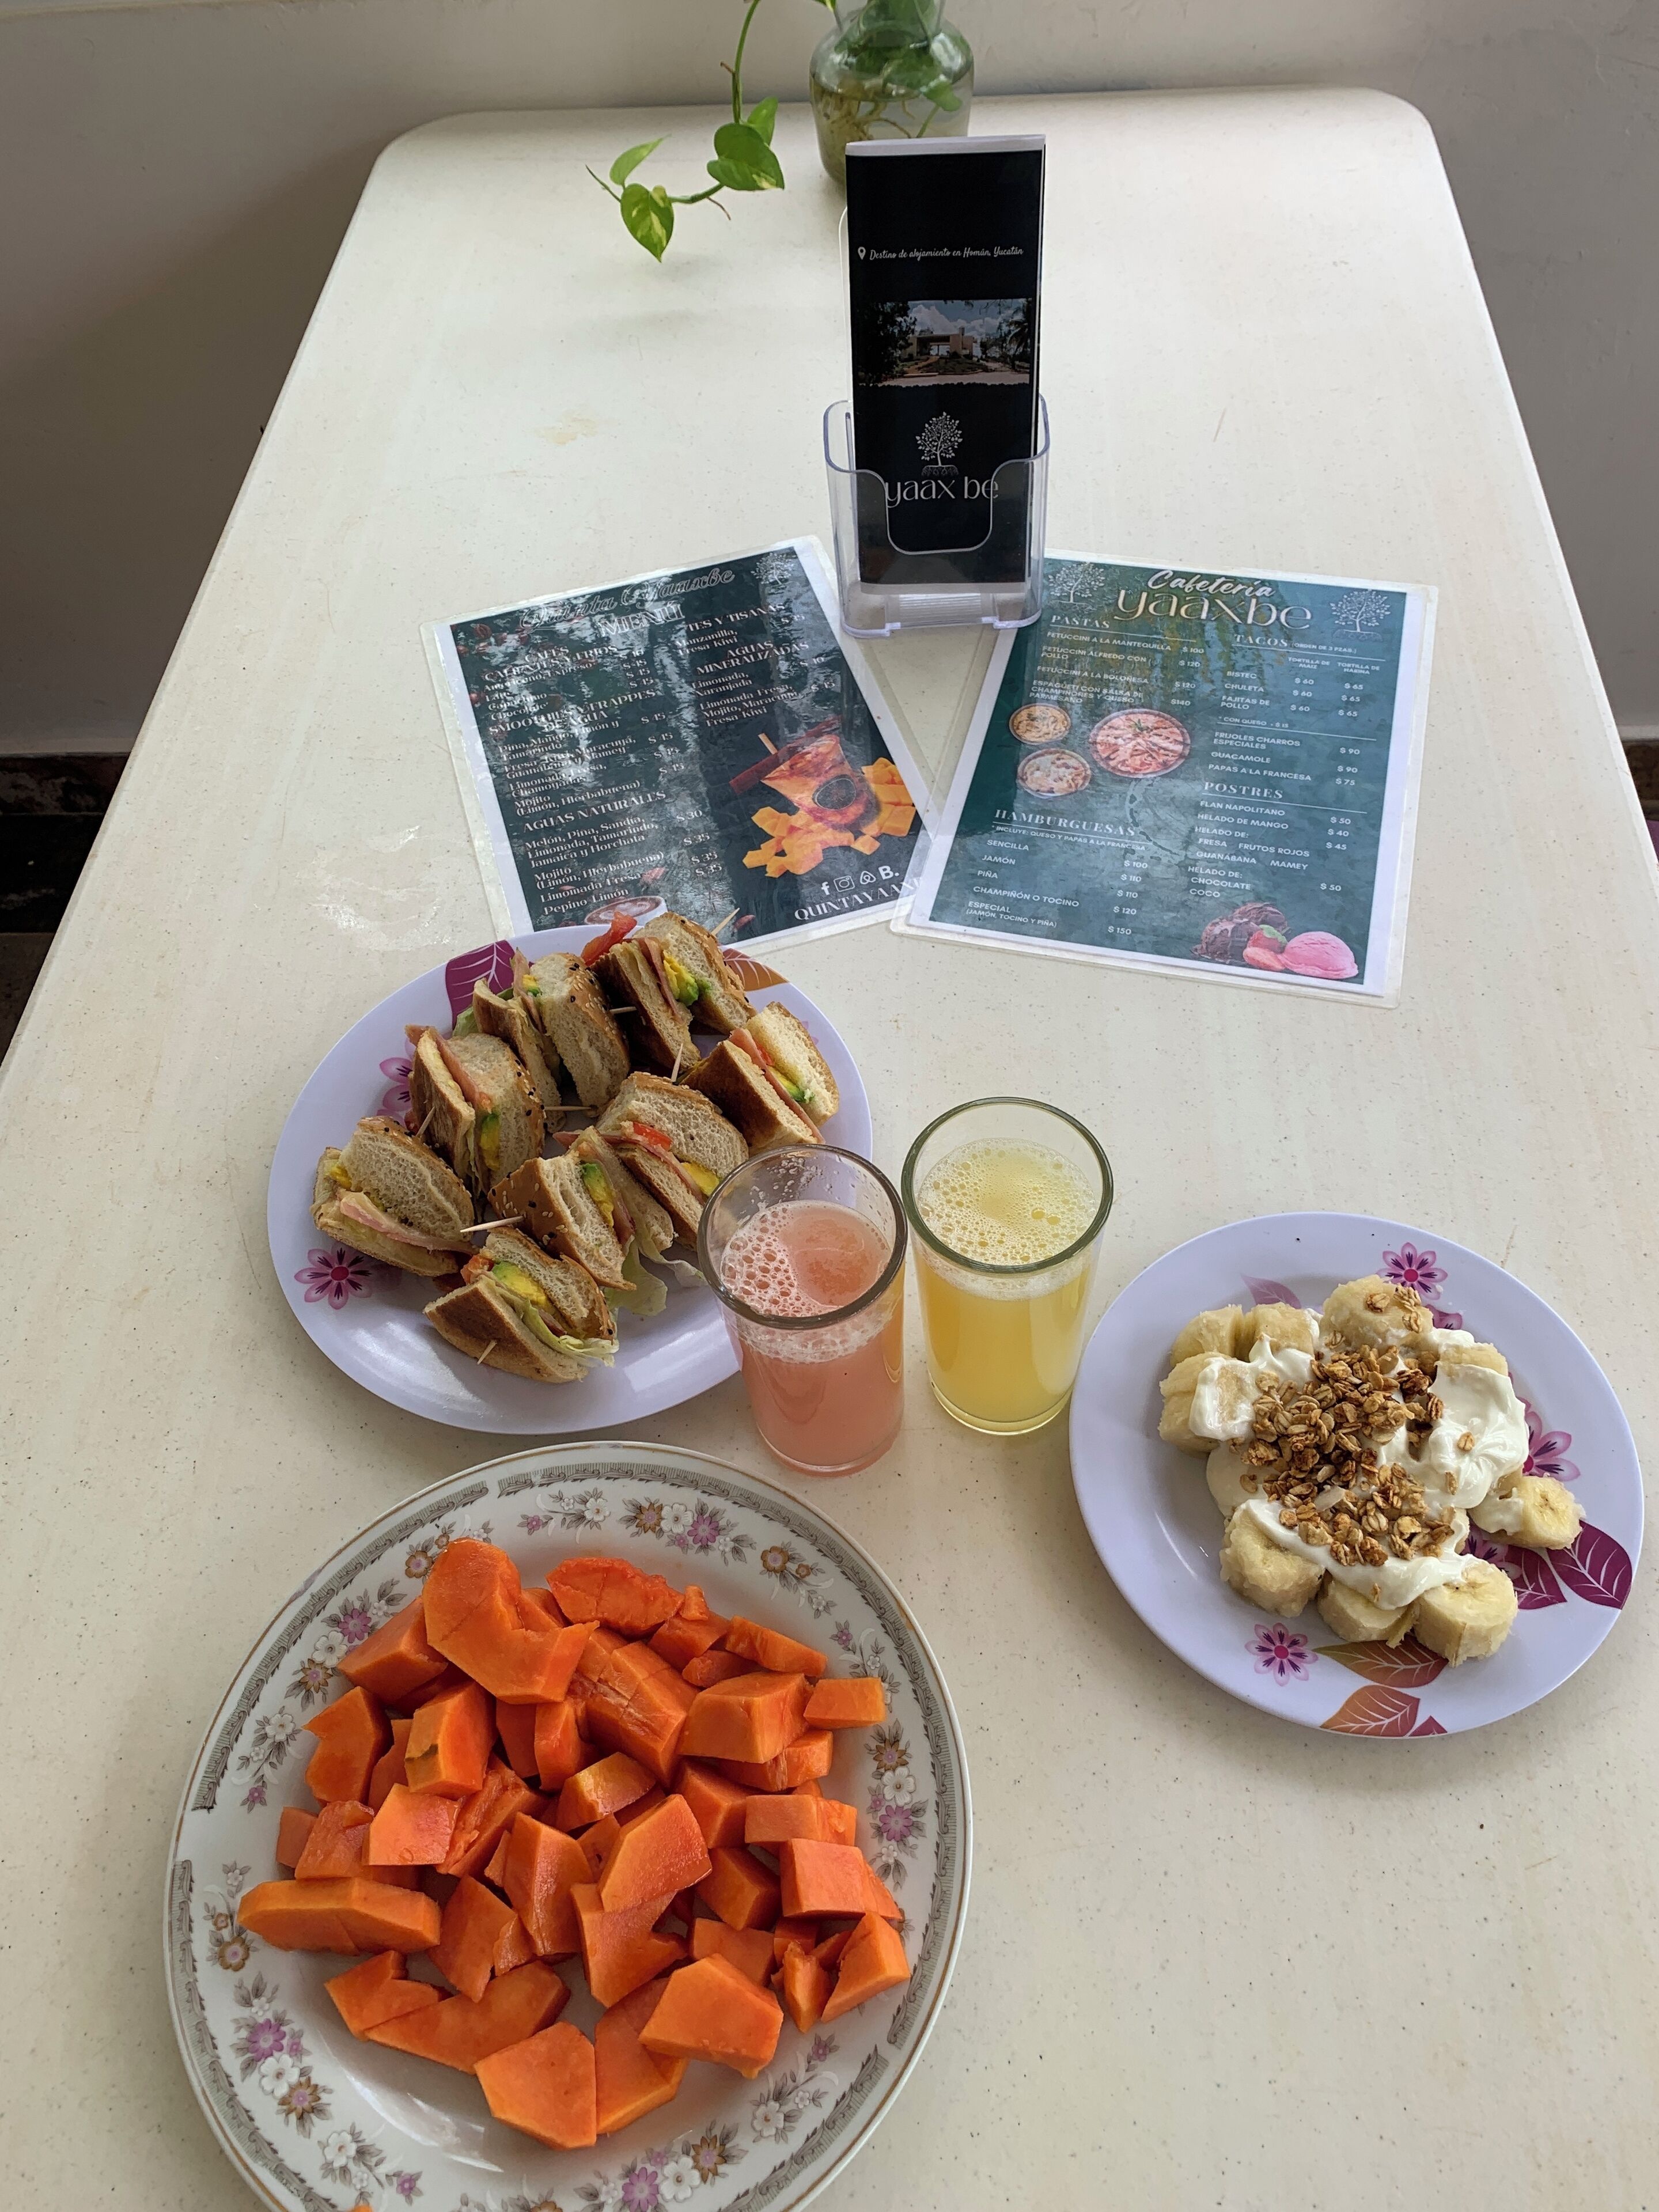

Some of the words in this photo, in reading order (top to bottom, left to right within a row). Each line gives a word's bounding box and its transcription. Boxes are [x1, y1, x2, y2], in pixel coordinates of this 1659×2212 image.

[870, 249, 896, 260] Destino
[899, 249, 908, 257] de
[909, 248, 950, 261] alojamiento
[993, 246, 1024, 257] Yucatán
[885, 479, 955, 508] yaax
[964, 476, 998, 499] be
[1147, 569, 1275, 597] Cafetería
[1114, 589, 1312, 630] yaaxbe
[715, 616, 726, 625] Y
[1051, 615, 1111, 628] PASTAS
[1046, 631, 1090, 641] FETUCCINI
[1112, 639, 1172, 650] MANTEQUILLA
[1233, 634, 1288, 647] TACOS
[725, 640, 775, 658] AGUAS
[1042, 646, 1086, 655] FETUCCINI
[1088, 651, 1125, 660] ALFREDO
[1036, 666, 1081, 675] FETUCCINI
[1226, 671, 1257, 679] BISTEC
[1224, 683, 1264, 692] CHULETA
[1029, 692, 1083, 703] PARMESANO
[1104, 695, 1134, 703] QUESO
[1222, 695, 1257, 704] FAJITAS
[1220, 702, 1249, 710] POLLO
[1213, 738, 1266, 749] ESPECIALES
[1214, 732, 1254, 741] FRIJOLES
[1256, 736, 1300, 747] CHARROS
[1210, 751, 1270, 763] GUACAMOLE
[1208, 764, 1238, 772] PAPAS
[1263, 770, 1311, 781] FRANCESA
[1203, 781, 1283, 799] POSTRES
[514, 794, 551, 809] Mojito
[1200, 801, 1223, 809] FLAN
[1225, 804, 1285, 816] NAPOLITANO
[521, 812, 575, 832] AGUAS
[576, 790, 666, 819] NATURALES
[994, 809, 1136, 836] HAMBURGUESAS
[1198, 813, 1234, 823] HELADO
[1251, 819, 1289, 830] MANGO
[525, 834, 566, 850] Melón,
[600, 815, 645, 831] Sandía,
[996, 826, 1029, 835] INCLUYE:
[1030, 831, 1055, 839] QUESO
[1107, 841, 1145, 850] FRANCESA
[1195, 826, 1232, 836] HELADO
[527, 838, 590, 859] Limonada,
[590, 821, 658, 844] Tamarindo,
[986, 839, 1029, 851] SENCILLA
[1198, 838, 1227, 847] FRESA
[1238, 843, 1275, 853] FRUTOS
[1278, 847, 1310, 857] ROJOS
[529, 850, 577, 868] Jamaica
[579, 849, 589, 857] y
[590, 834, 645, 853] Horchata
[982, 853, 1016, 865] JAMÓN
[1270, 859, 1308, 870] MAMEY
[534, 866, 572, 882] Mojito
[977, 869, 999, 878] PIÑA
[1188, 866, 1225, 876] HELADO
[1191, 876, 1251, 890] CHOCOLATE
[972, 885, 1031, 900] CHAMPIÑÓN
[1041, 896, 1080, 907] TOCINO
[1189, 888, 1220, 897] COCO
[543, 897, 588, 916] Pepino
[968, 901, 1012, 913] ESPECIAL
[965, 907, 998, 919] (JAMÓN,
[999, 914, 1029, 923] TOCINO
[1036, 918, 1057, 927] PIÑA)
